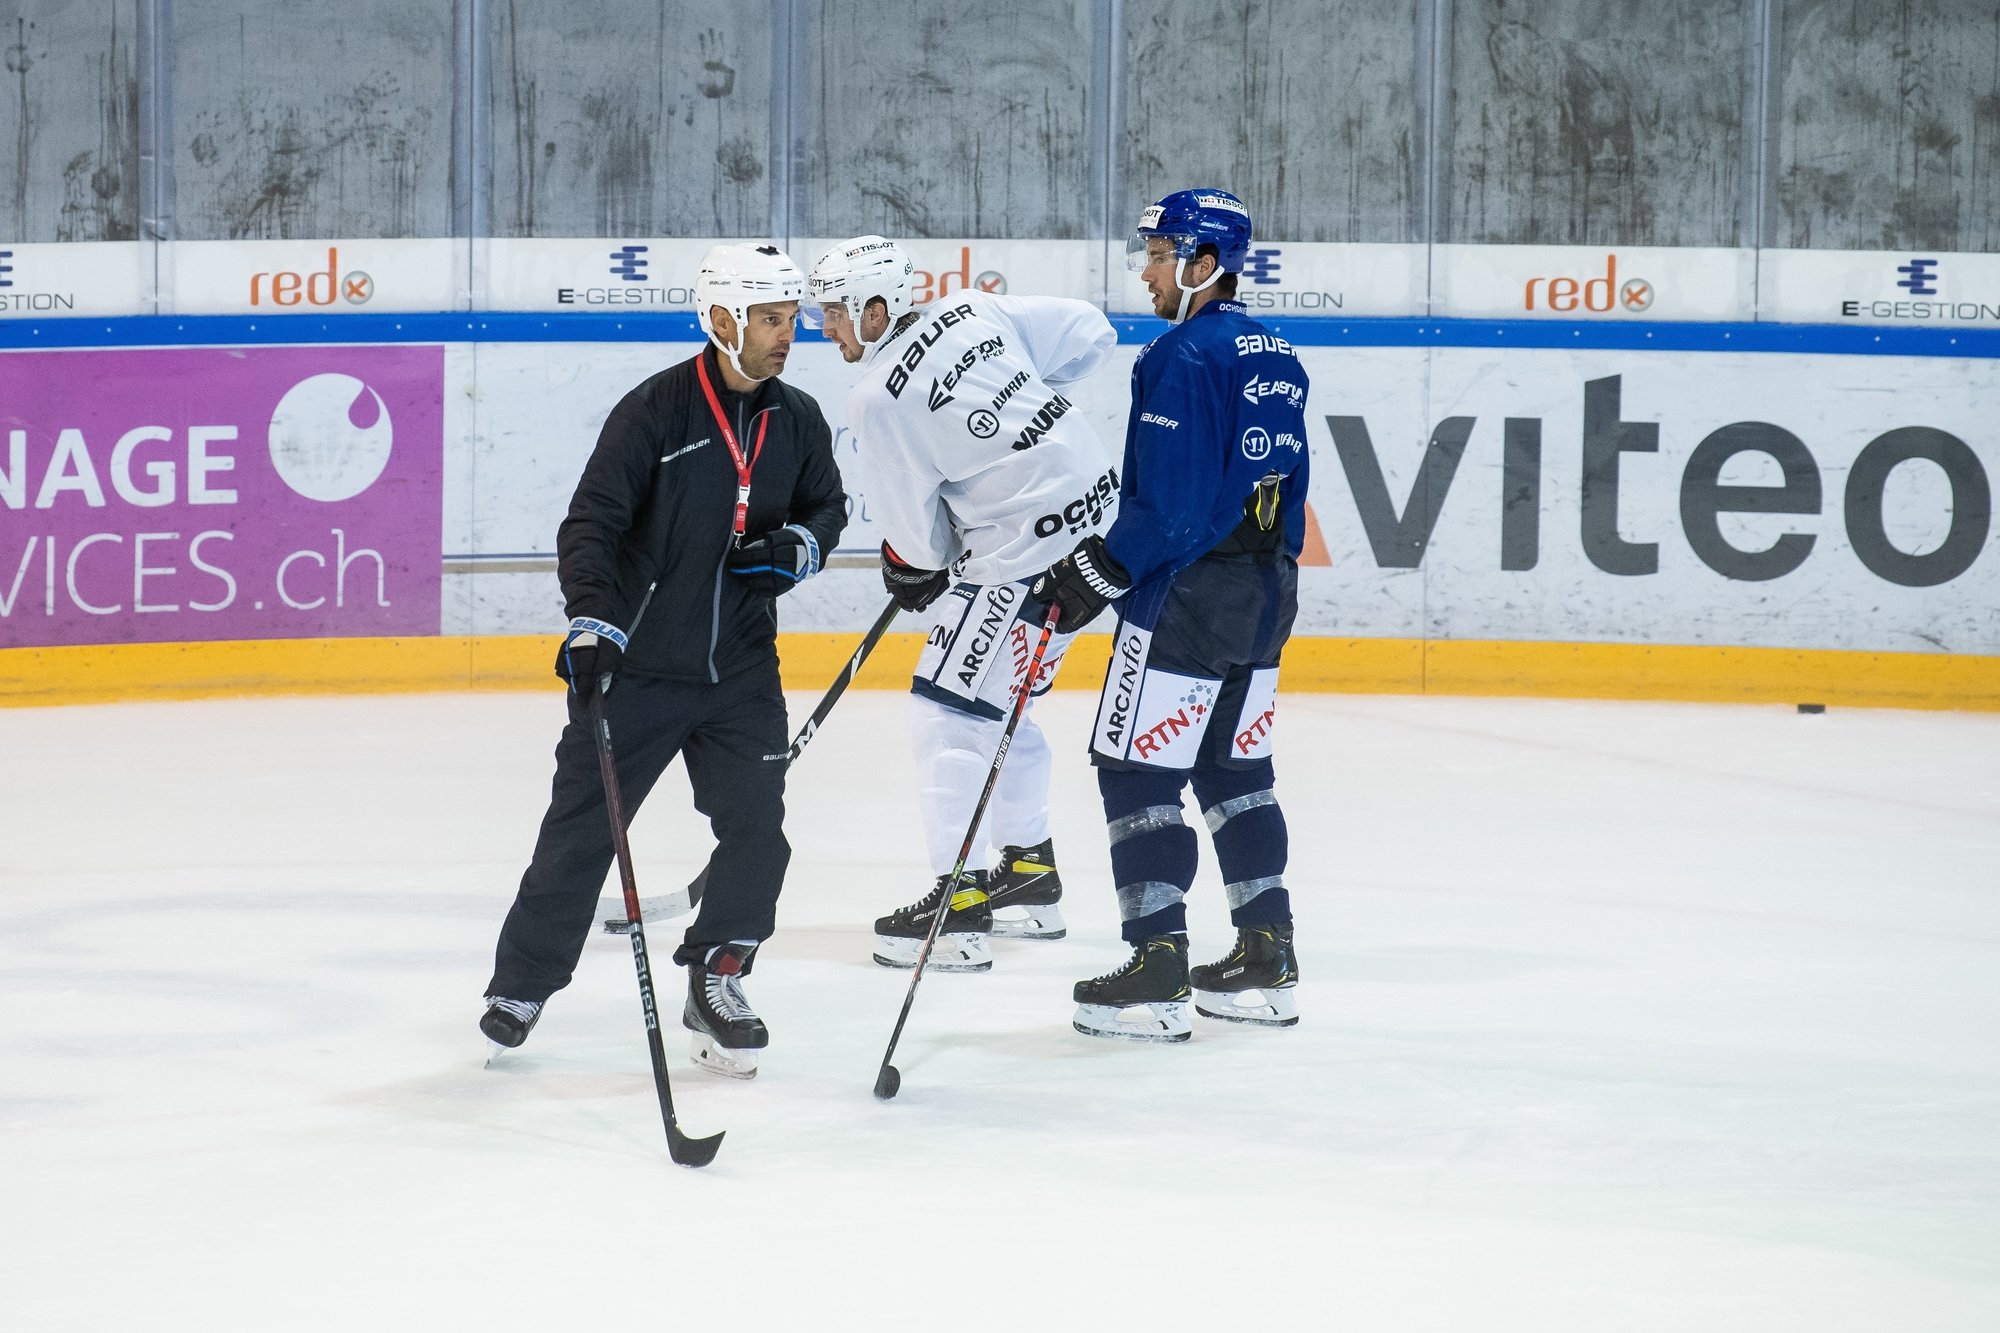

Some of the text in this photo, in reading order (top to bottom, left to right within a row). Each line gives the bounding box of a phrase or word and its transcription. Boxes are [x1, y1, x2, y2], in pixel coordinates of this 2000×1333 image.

[885, 304, 977, 400] BAUER
[1010, 623, 1029, 678] RTN
[993, 734, 1011, 770] BAUER
[1133, 708, 1191, 760] RTN
